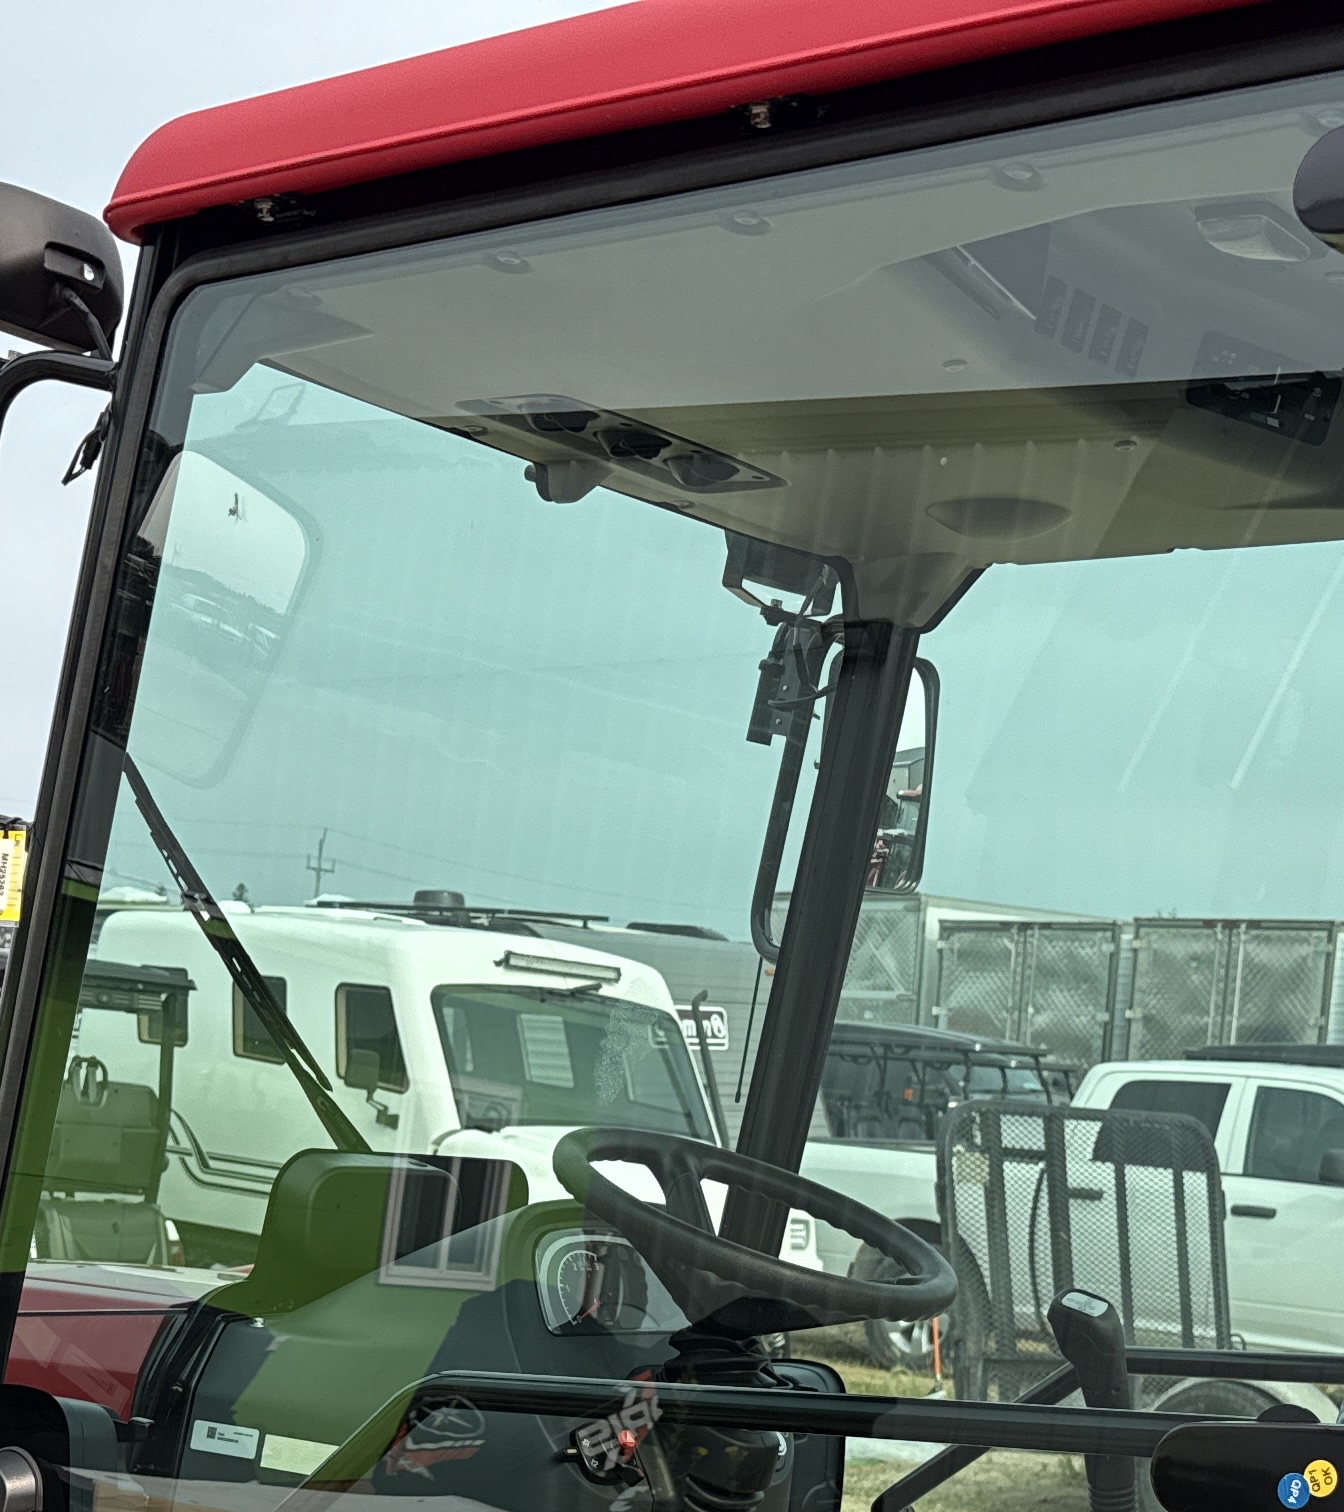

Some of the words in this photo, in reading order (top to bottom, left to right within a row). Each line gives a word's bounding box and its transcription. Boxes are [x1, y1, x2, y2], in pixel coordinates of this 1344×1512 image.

[1308, 1469, 1321, 1493] QP1
[1321, 1467, 1333, 1486] OK
[1287, 1479, 1302, 1504] QP4
